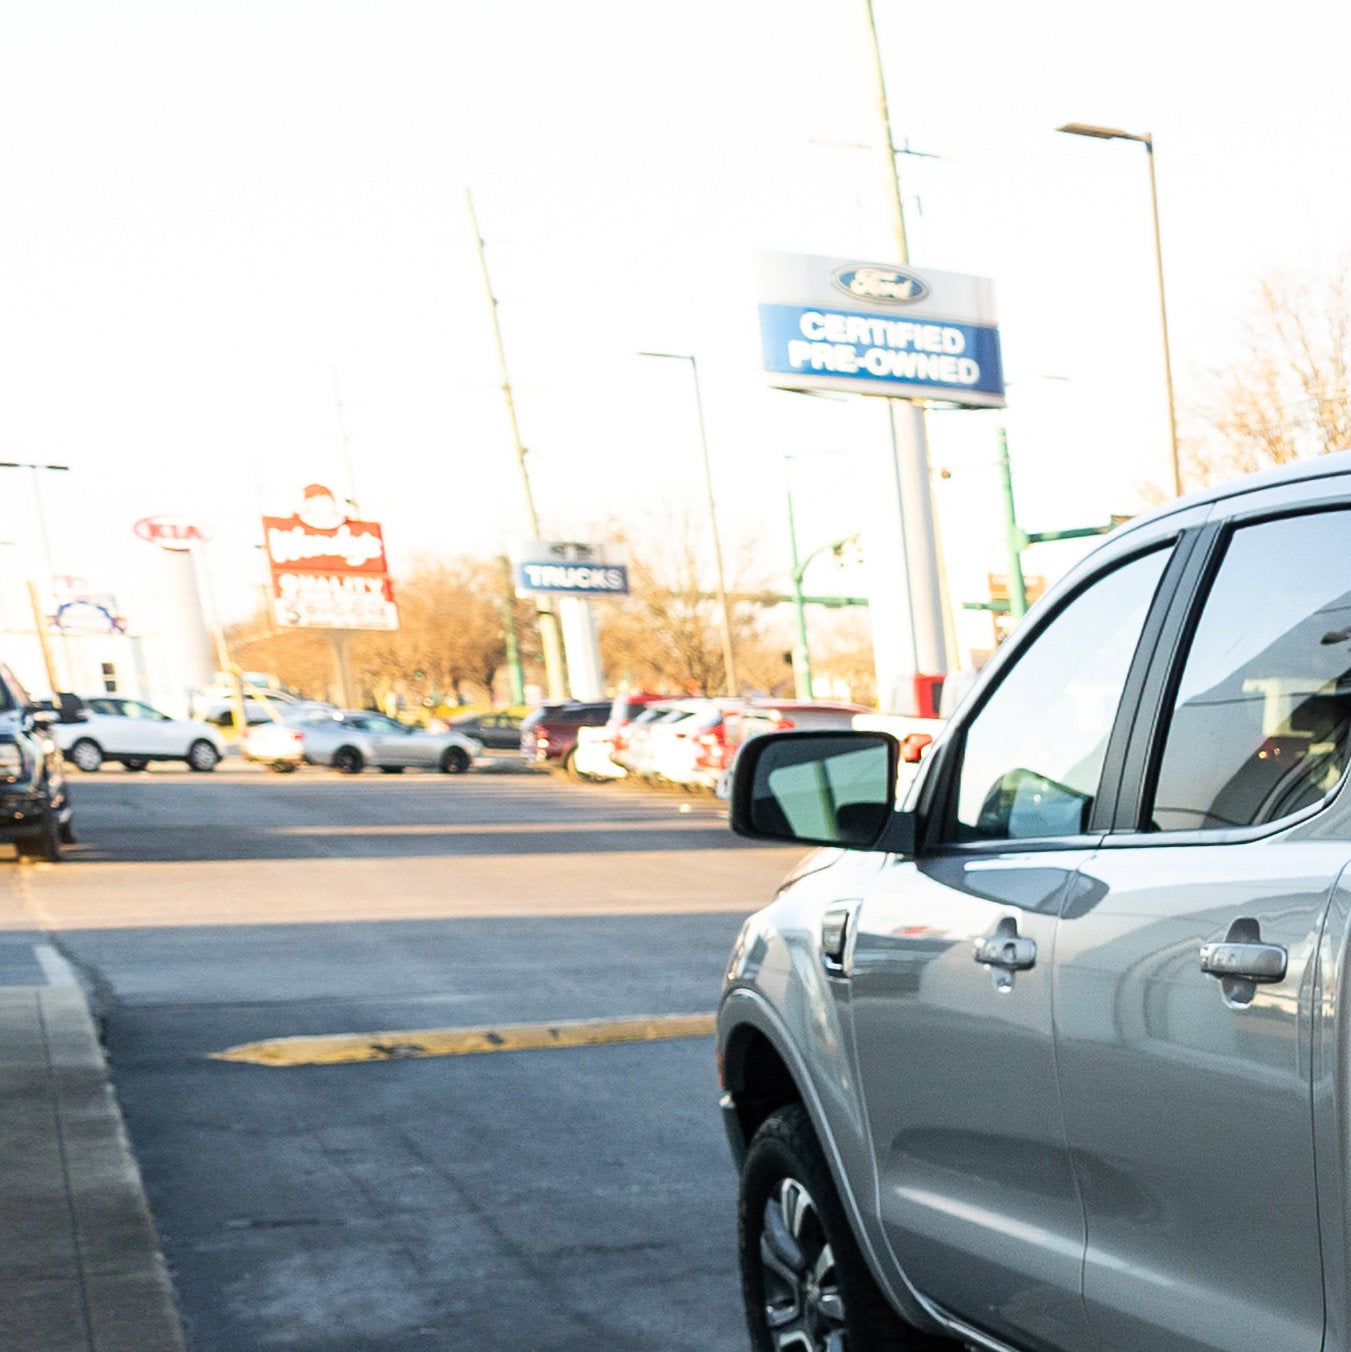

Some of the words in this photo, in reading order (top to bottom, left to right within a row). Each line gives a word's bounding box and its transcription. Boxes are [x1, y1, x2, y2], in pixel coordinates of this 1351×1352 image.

[800, 311, 965, 354] CERTIFIED
[787, 340, 980, 385] PRE-OWNED
[149, 523, 203, 539] KIA
[523, 564, 622, 590] TRUCKS
